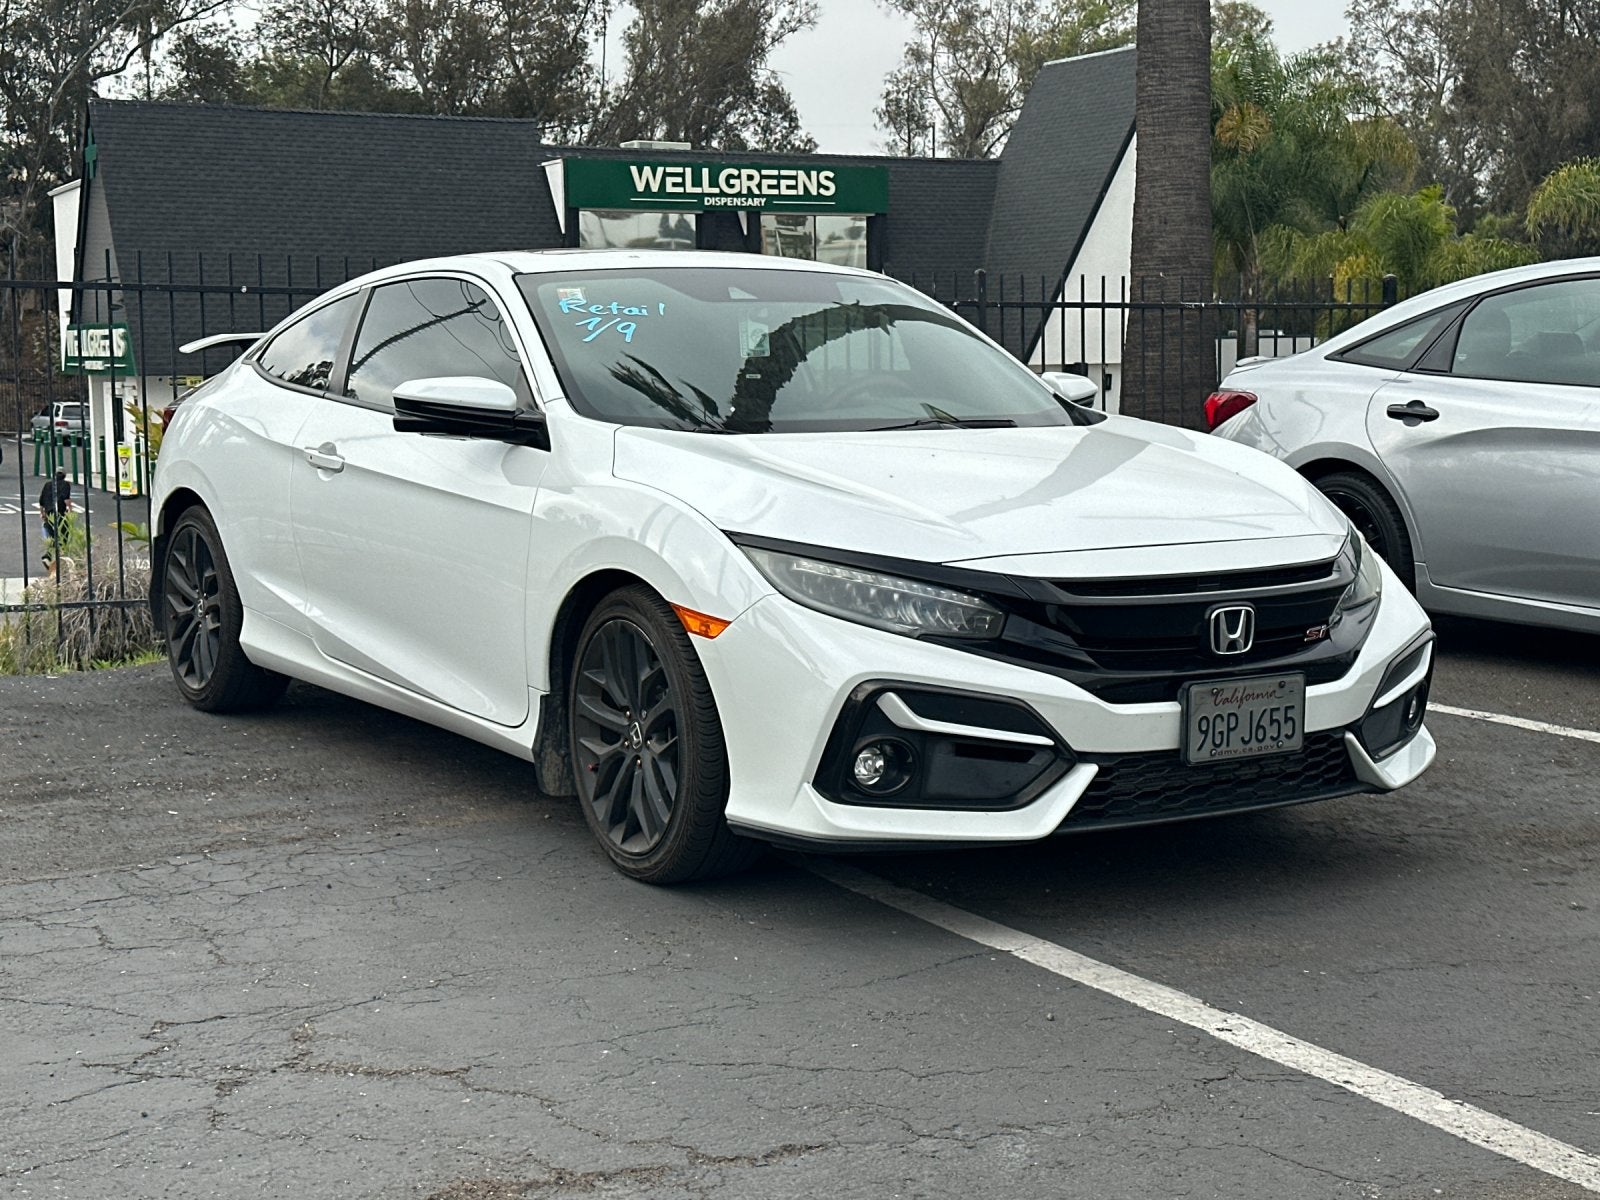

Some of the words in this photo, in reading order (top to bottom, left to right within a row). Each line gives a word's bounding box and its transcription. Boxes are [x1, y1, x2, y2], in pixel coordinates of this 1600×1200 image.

[630, 165, 836, 196] WELLGREENS
[704, 197, 766, 207] DISPENSARY
[559, 299, 665, 316] Retail
[1212, 687, 1284, 709] California
[1197, 705, 1296, 752] 9GPJ655
[1217, 744, 1276, 757] dmv.ca.gov
